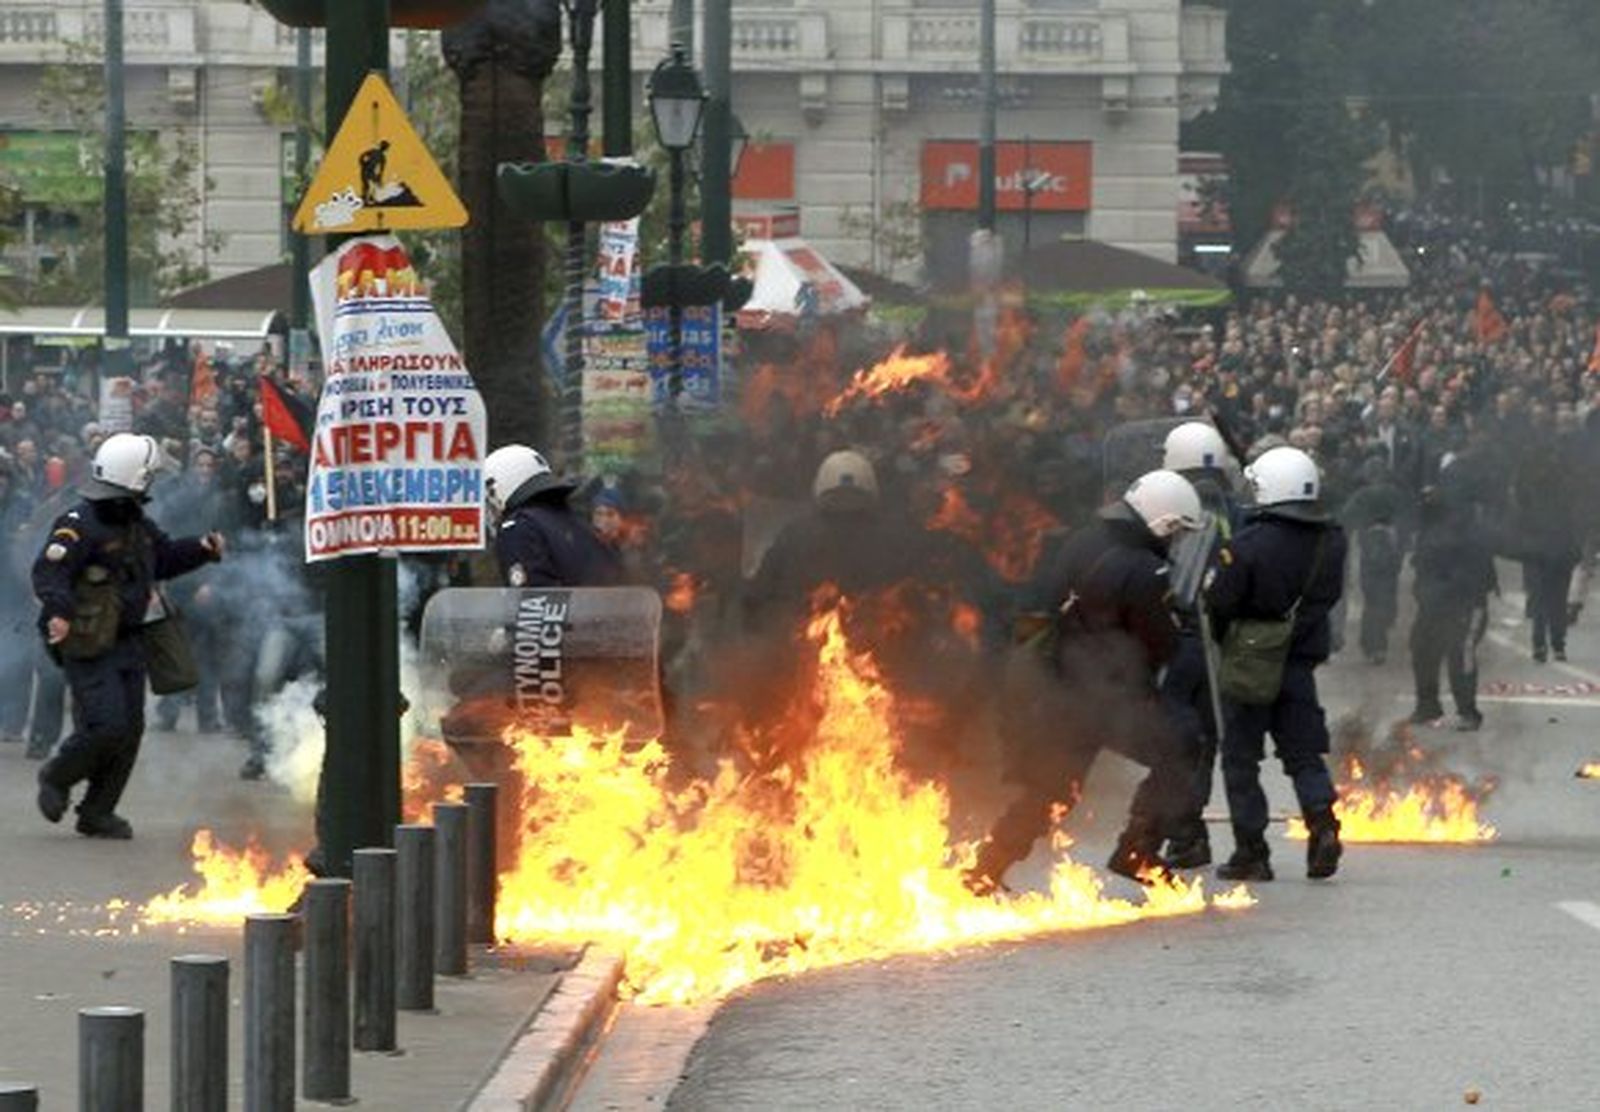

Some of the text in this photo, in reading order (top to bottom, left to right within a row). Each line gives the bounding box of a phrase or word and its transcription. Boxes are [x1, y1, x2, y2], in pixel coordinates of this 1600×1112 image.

[403, 397, 468, 415] ΤΟΥΣ
[313, 420, 478, 469] ΑΠΕΡΓΙΑ
[346, 468, 482, 508] ΔΕΚΕΜΒΡΗ
[398, 514, 450, 541] 11:00
